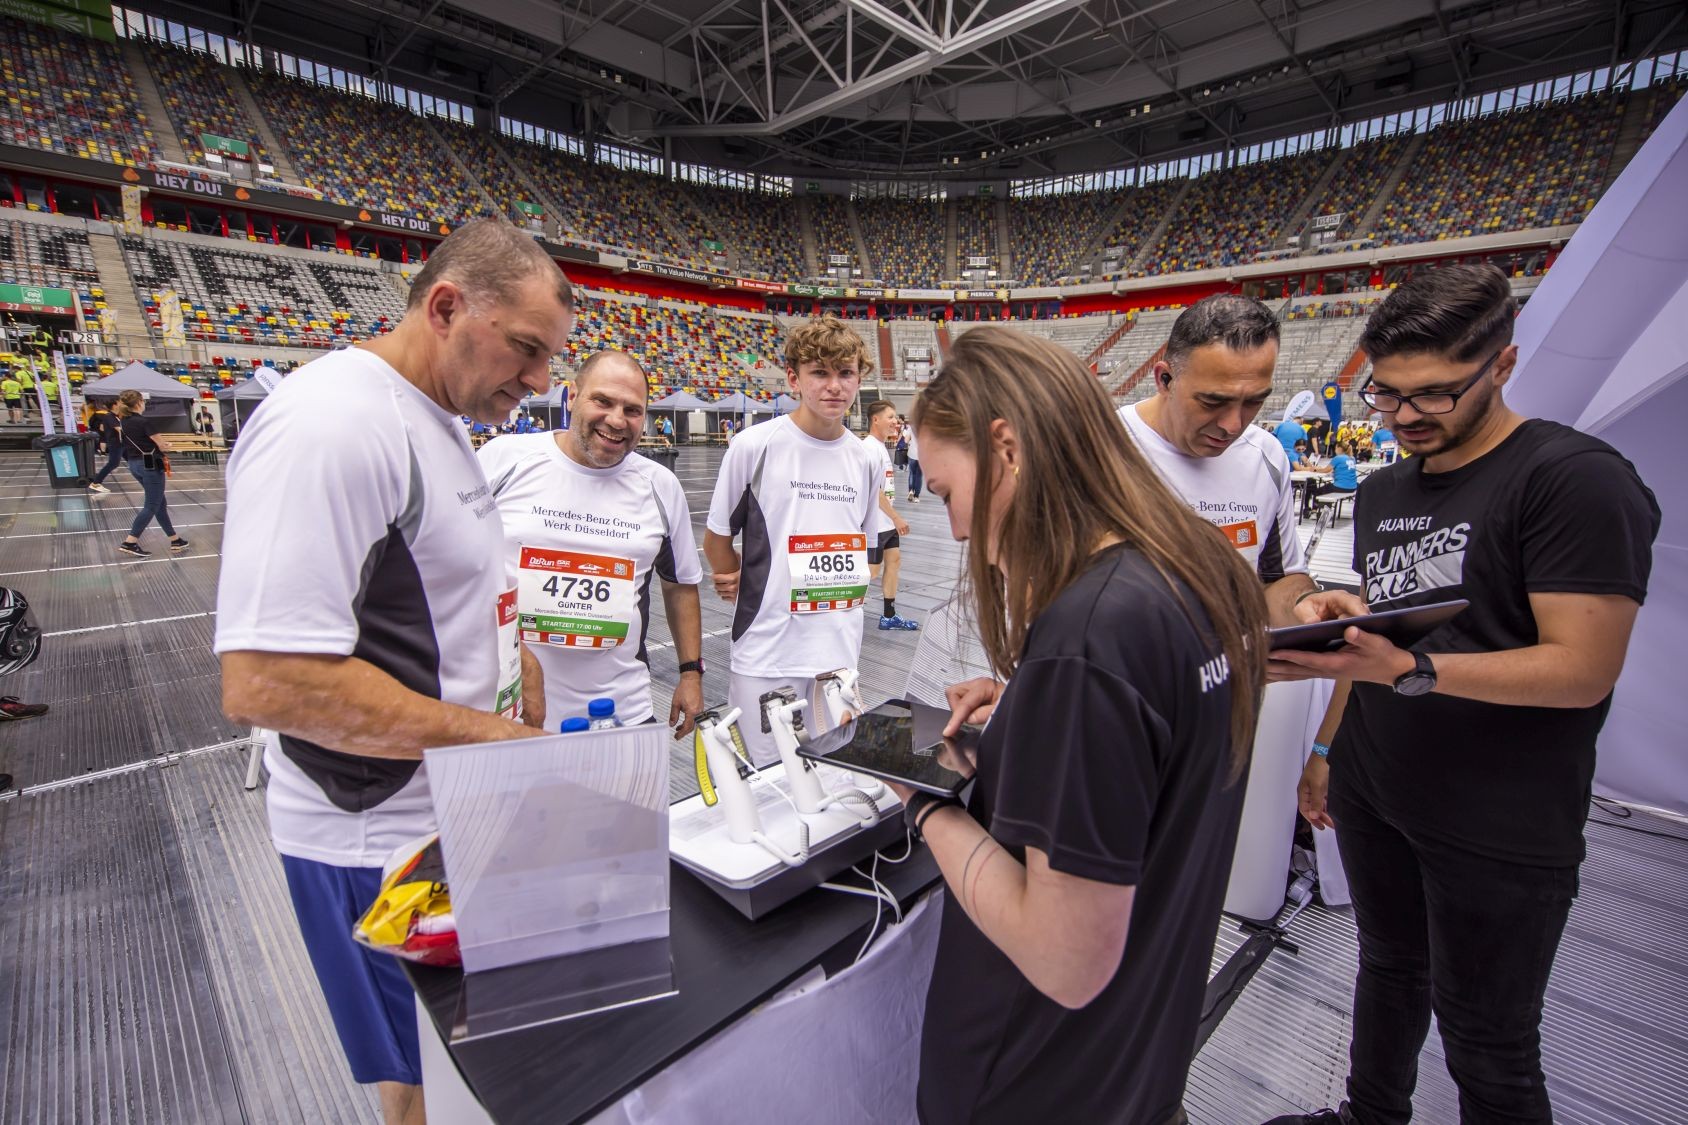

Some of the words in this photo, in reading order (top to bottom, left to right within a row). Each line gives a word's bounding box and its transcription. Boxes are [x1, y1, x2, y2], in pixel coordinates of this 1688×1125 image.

[155, 173, 189, 192] HEY
[194, 179, 222, 196] DU!
[381, 213, 407, 228] HEY
[409, 218, 430, 232] DU!
[656, 265, 668, 274] The
[668, 268, 685, 277] Value
[53, 306, 65, 314] 28
[79, 334, 95, 343] 28
[790, 481, 841, 492] Mercedes-Benz
[817, 492, 855, 504] Düsseldorf
[1228, 501, 1258, 515] Group
[531, 505, 611, 526] Mercedes-Benz
[612, 517, 641, 531] Group
[1377, 516, 1432, 532] HUAWEI
[543, 519, 572, 532] Werk
[574, 524, 631, 540] Düsseldorf
[1366, 522, 1471, 579] RUNNERS
[808, 554, 855, 573] 4865
[542, 575, 611, 602] 4736
[1367, 568, 1419, 602] CLUB
[534, 607, 573, 616] Mercedes-Benz
[557, 600, 593, 611] GüNTER
[542, 620, 575, 629] STARTZEIT
[576, 623, 592, 631] 17:00
